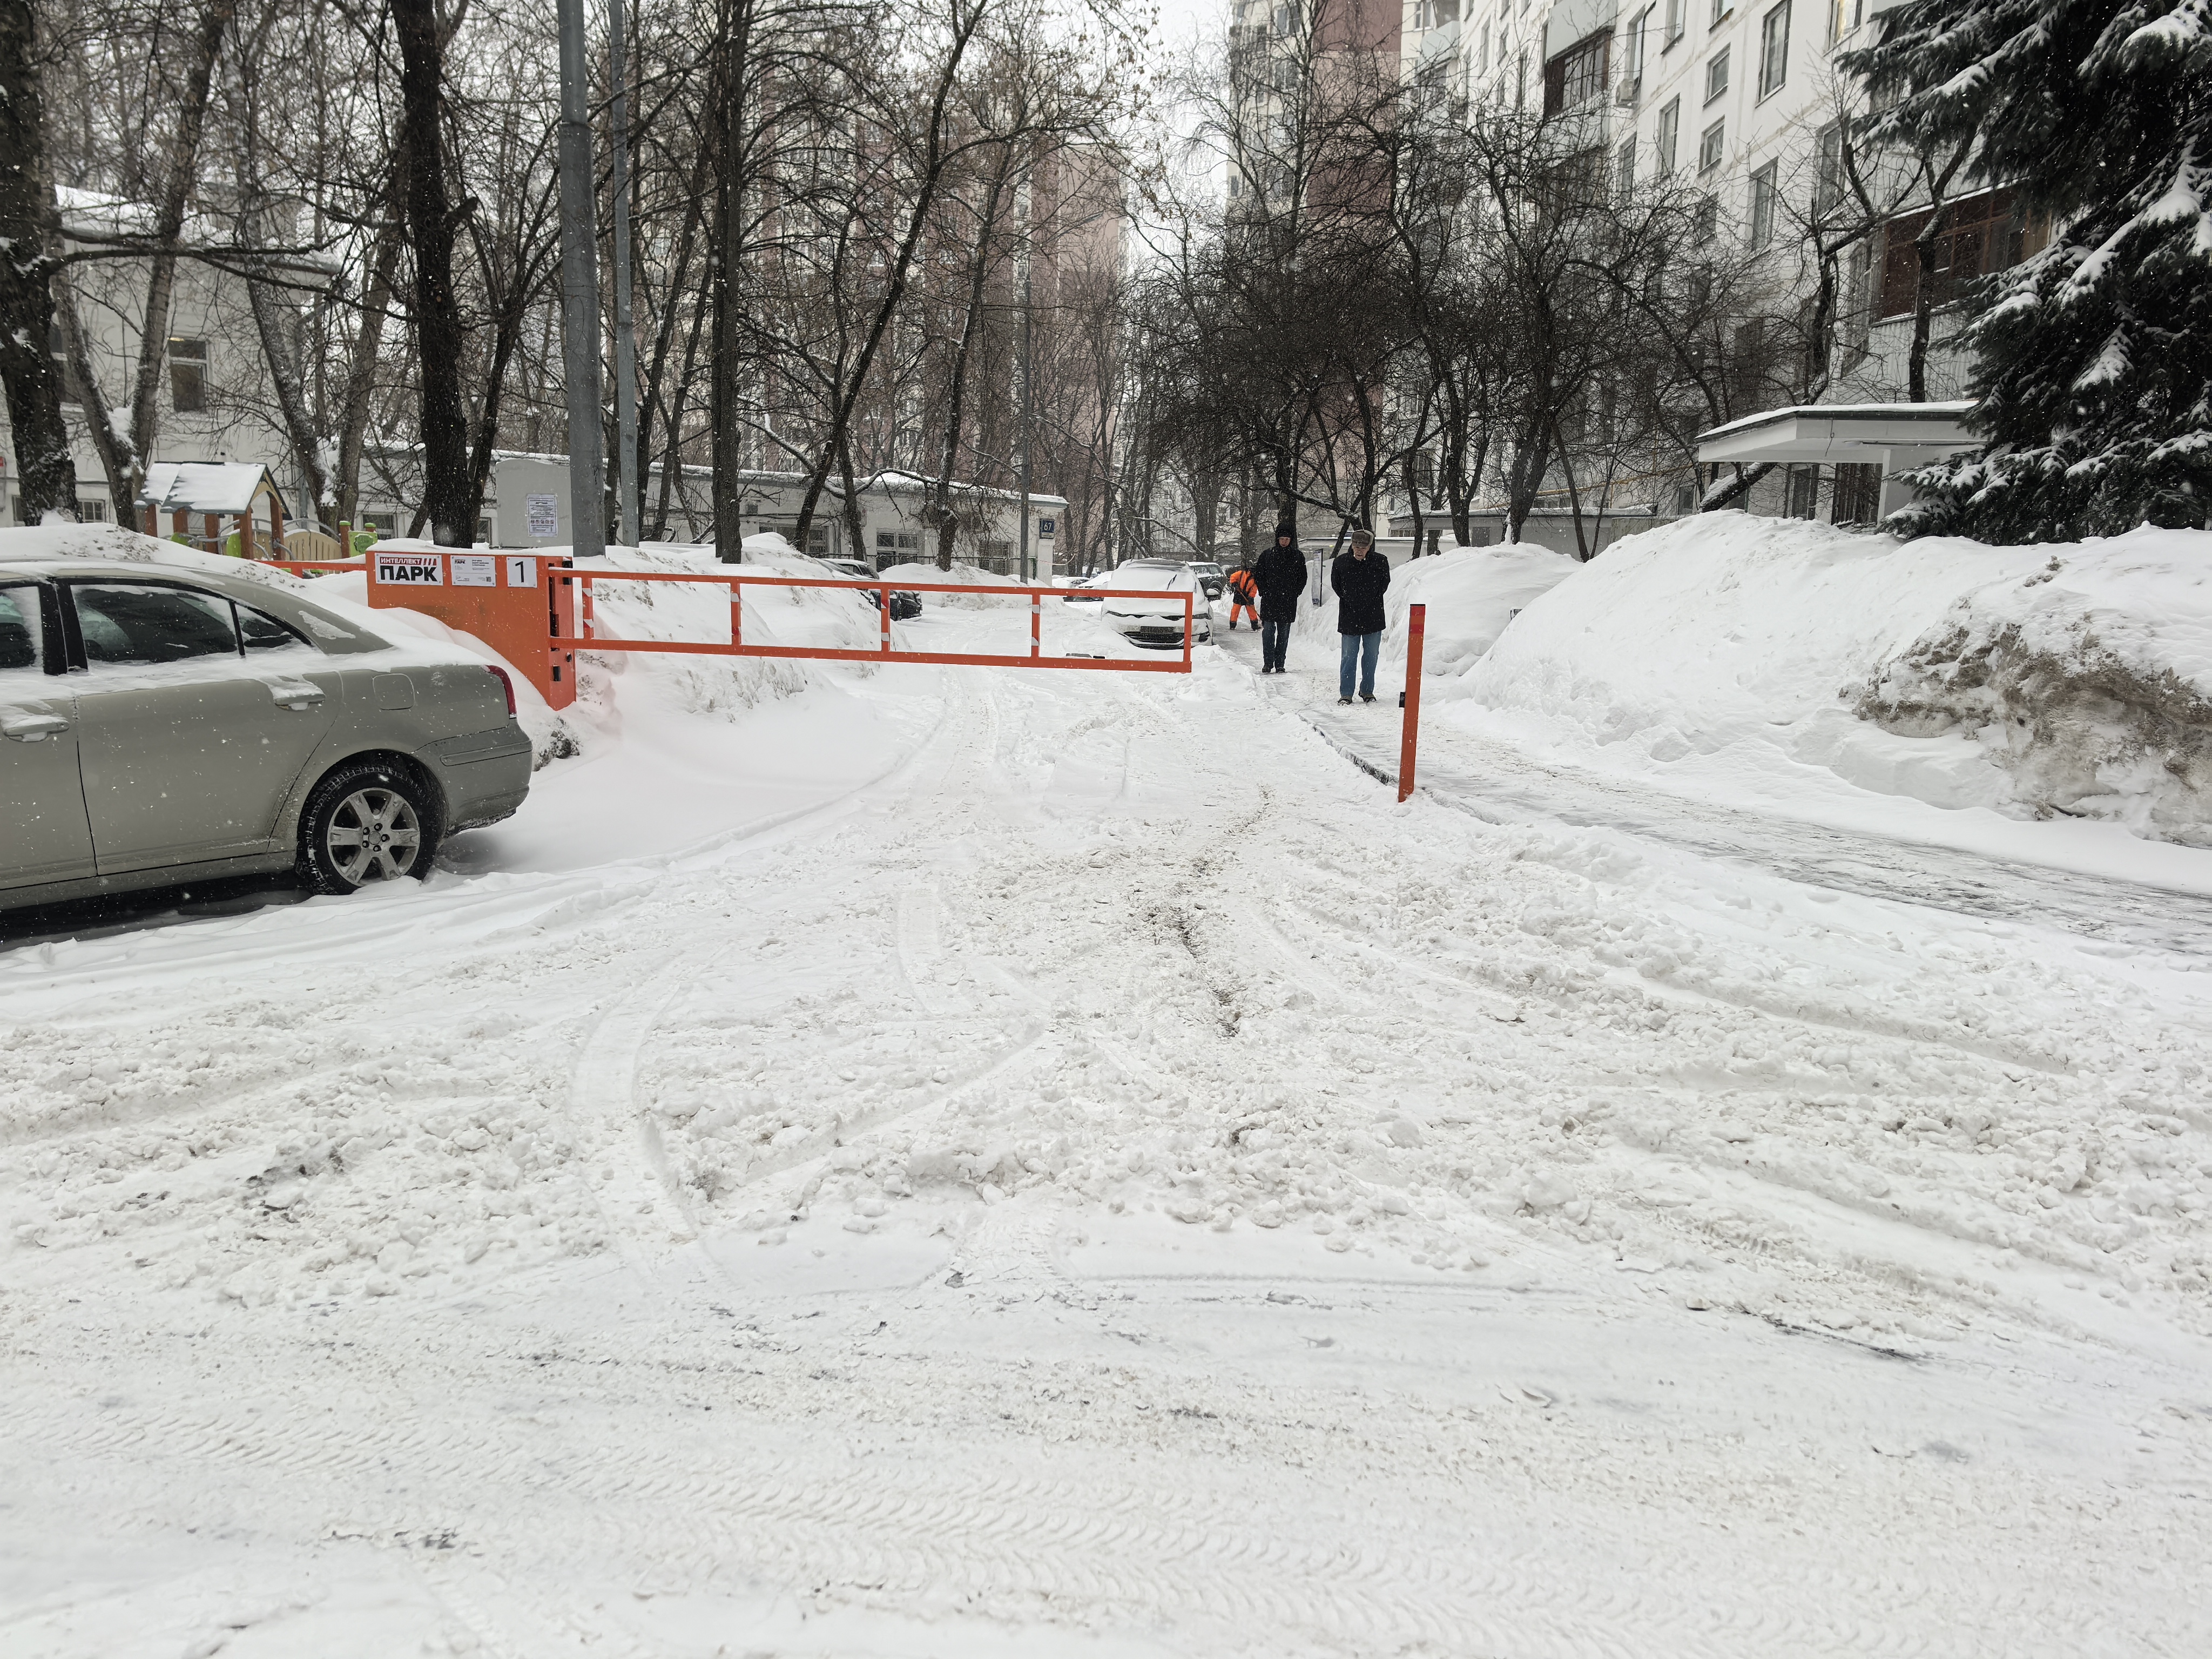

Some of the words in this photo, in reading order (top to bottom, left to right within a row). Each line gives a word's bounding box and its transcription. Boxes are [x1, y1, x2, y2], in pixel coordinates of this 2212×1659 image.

[1044, 522, 1052, 530] 67
[380, 565, 438, 582] ПАРК
[515, 561, 524, 583] 1
